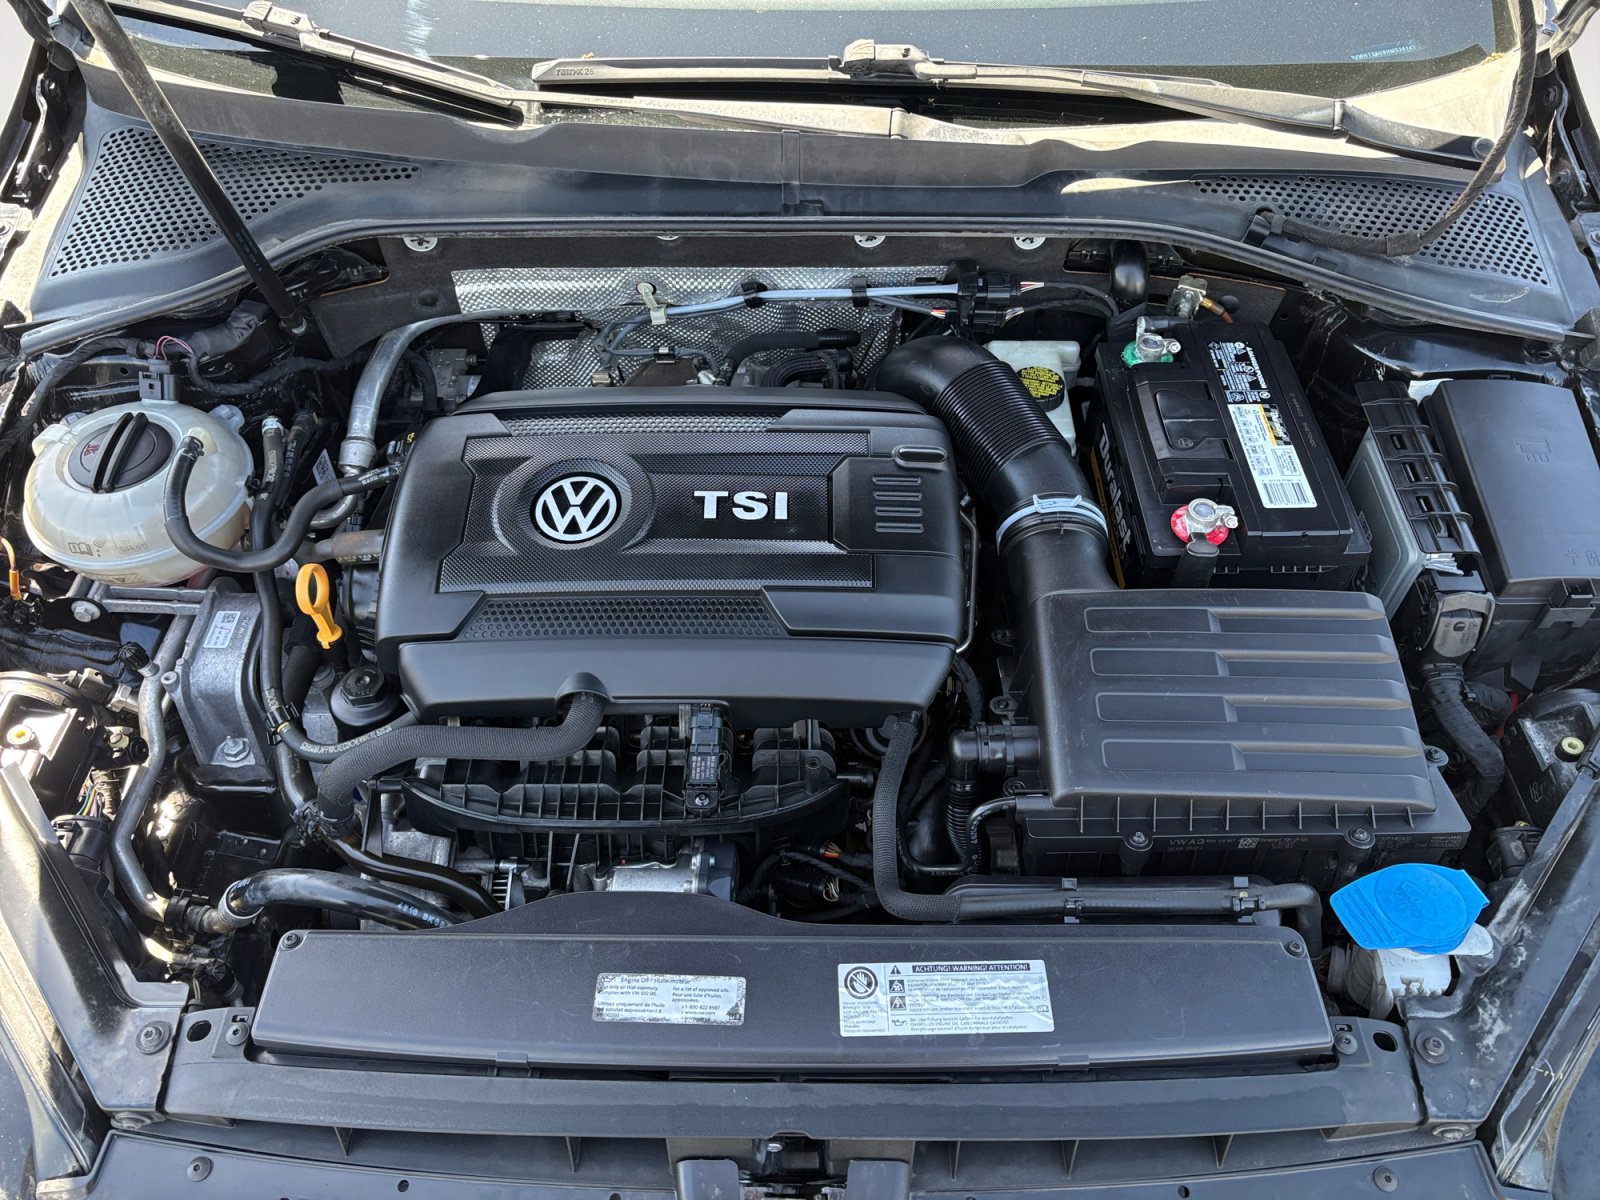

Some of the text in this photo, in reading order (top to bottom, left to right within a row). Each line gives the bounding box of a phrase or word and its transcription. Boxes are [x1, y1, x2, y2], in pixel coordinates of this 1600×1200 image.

[1099, 422, 1132, 554] Duralast
[693, 490, 788, 521] TSI
[620, 976, 640, 984] Engine
